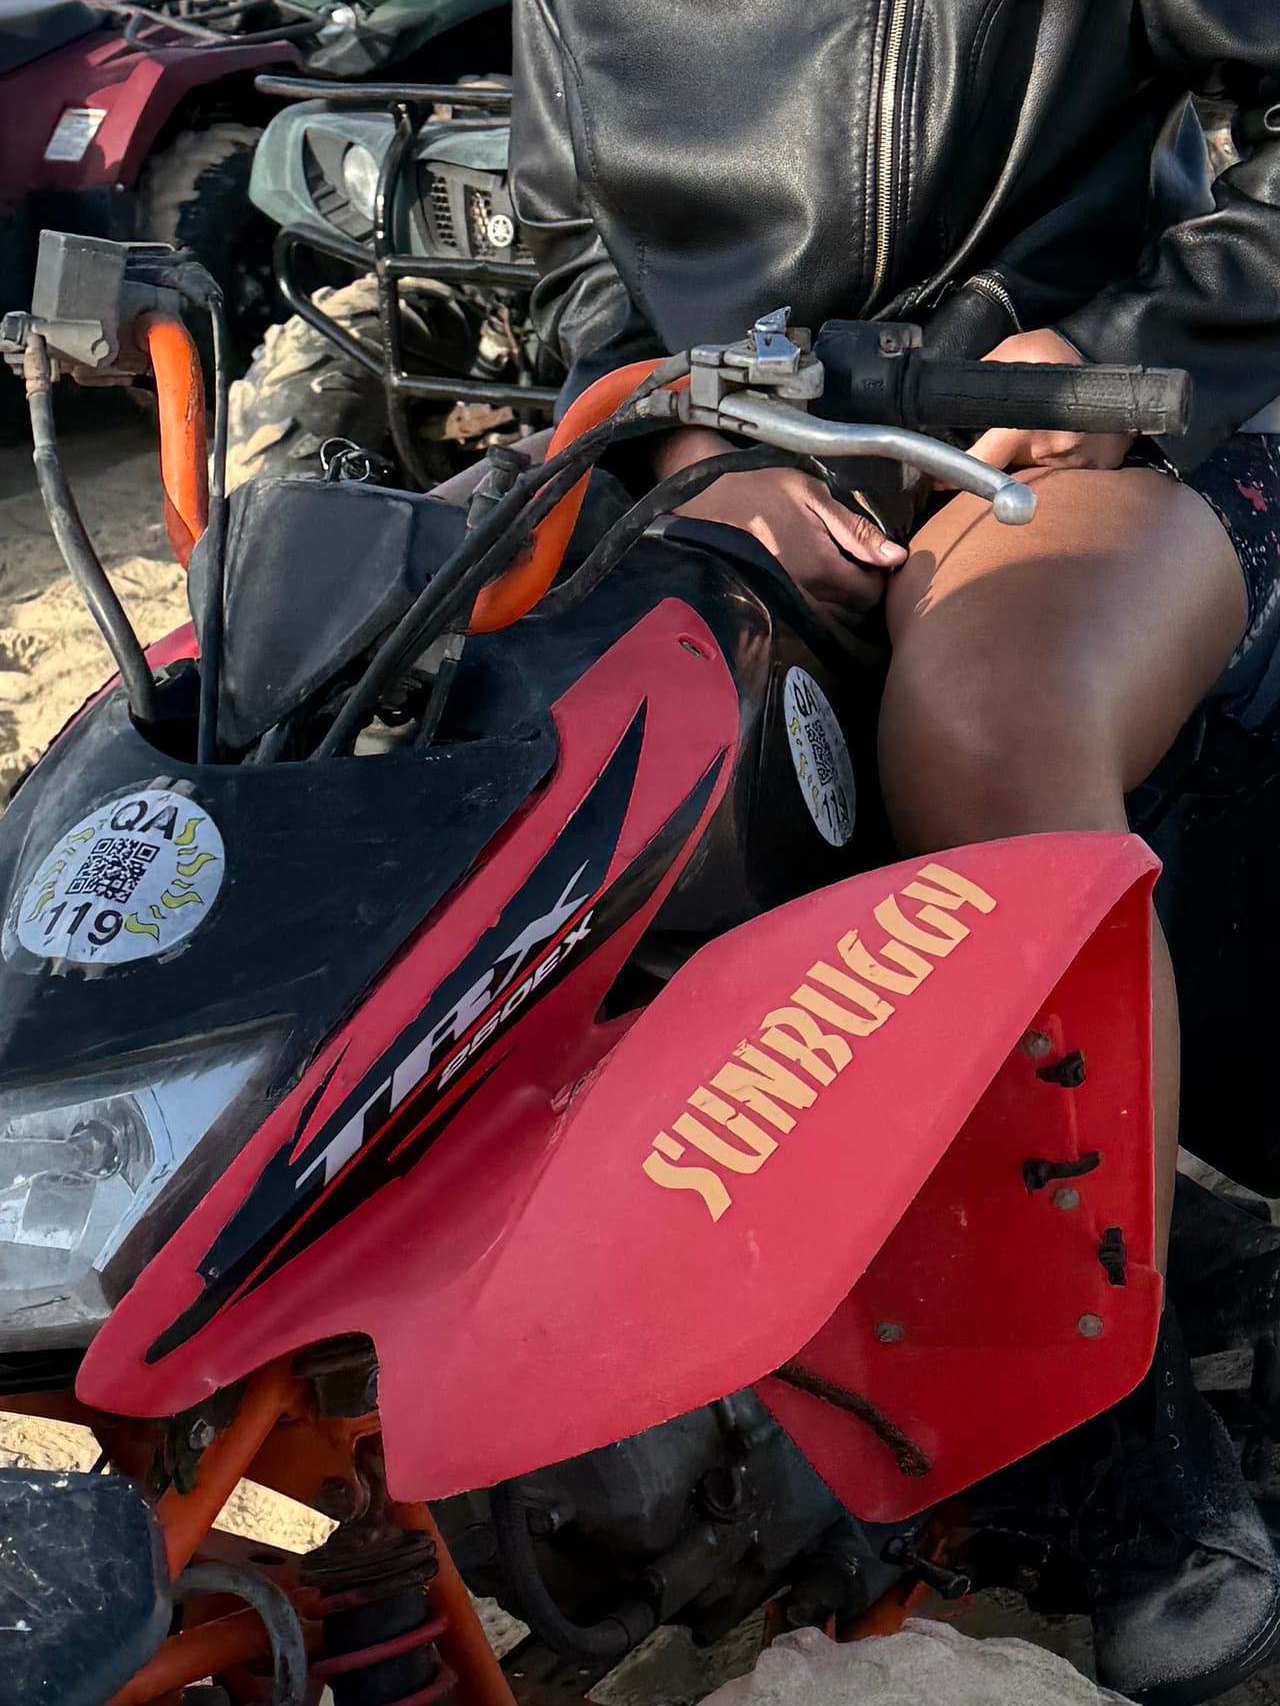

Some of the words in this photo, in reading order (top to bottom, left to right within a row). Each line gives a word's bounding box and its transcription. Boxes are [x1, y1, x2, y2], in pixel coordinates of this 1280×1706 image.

[110, 800, 179, 840] QA
[43, 901, 124, 945] 119
[437, 910, 592, 1091] 250EX
[295, 859, 590, 1189] TRX
[641, 863, 998, 1223] SUNBUGGY
